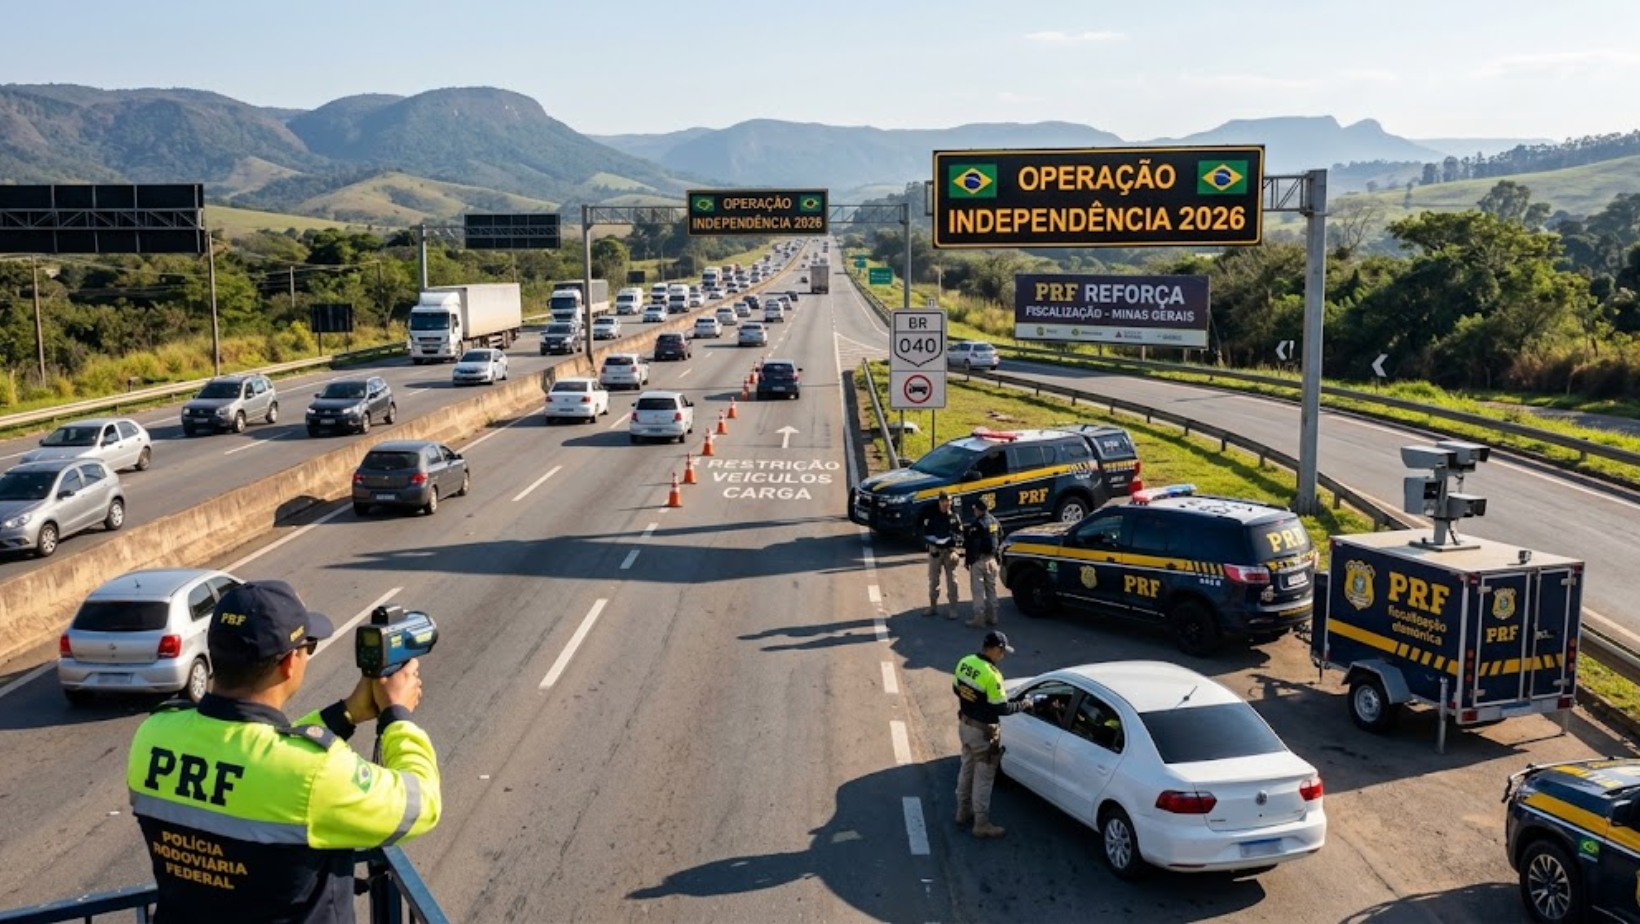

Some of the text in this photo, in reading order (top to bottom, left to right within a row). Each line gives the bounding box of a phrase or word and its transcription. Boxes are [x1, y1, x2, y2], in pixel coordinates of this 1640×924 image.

[1017, 159, 1177, 196] OPERAÇÃO
[723, 195, 792, 212] OPERAÇÃO
[692, 215, 823, 230] INDEPENDÊNCIA 2026
[948, 201, 1246, 234] INDEPENDÊNCIA 2026
[1034, 282, 1185, 309] PRF REFORÇA
[908, 317, 927, 329] BR
[1026, 305, 1102, 320] FISCALIZAÇÃO
[1112, 310, 1149, 321] MINAS
[1151, 311, 1195, 323] GERAIS
[899, 338, 937, 354] 040
[707, 459, 841, 472] RESTRIÇÃO
[712, 472, 833, 484] VEÍCULOS
[723, 487, 812, 500] CARGA
[1018, 488, 1049, 505] PRF
[1124, 575, 1161, 598] PRF
[1388, 571, 1450, 615] PRF
[1486, 625, 1519, 644] PRF
[144, 747, 245, 806] PRF
[166, 862, 235, 890] FEDERAL
